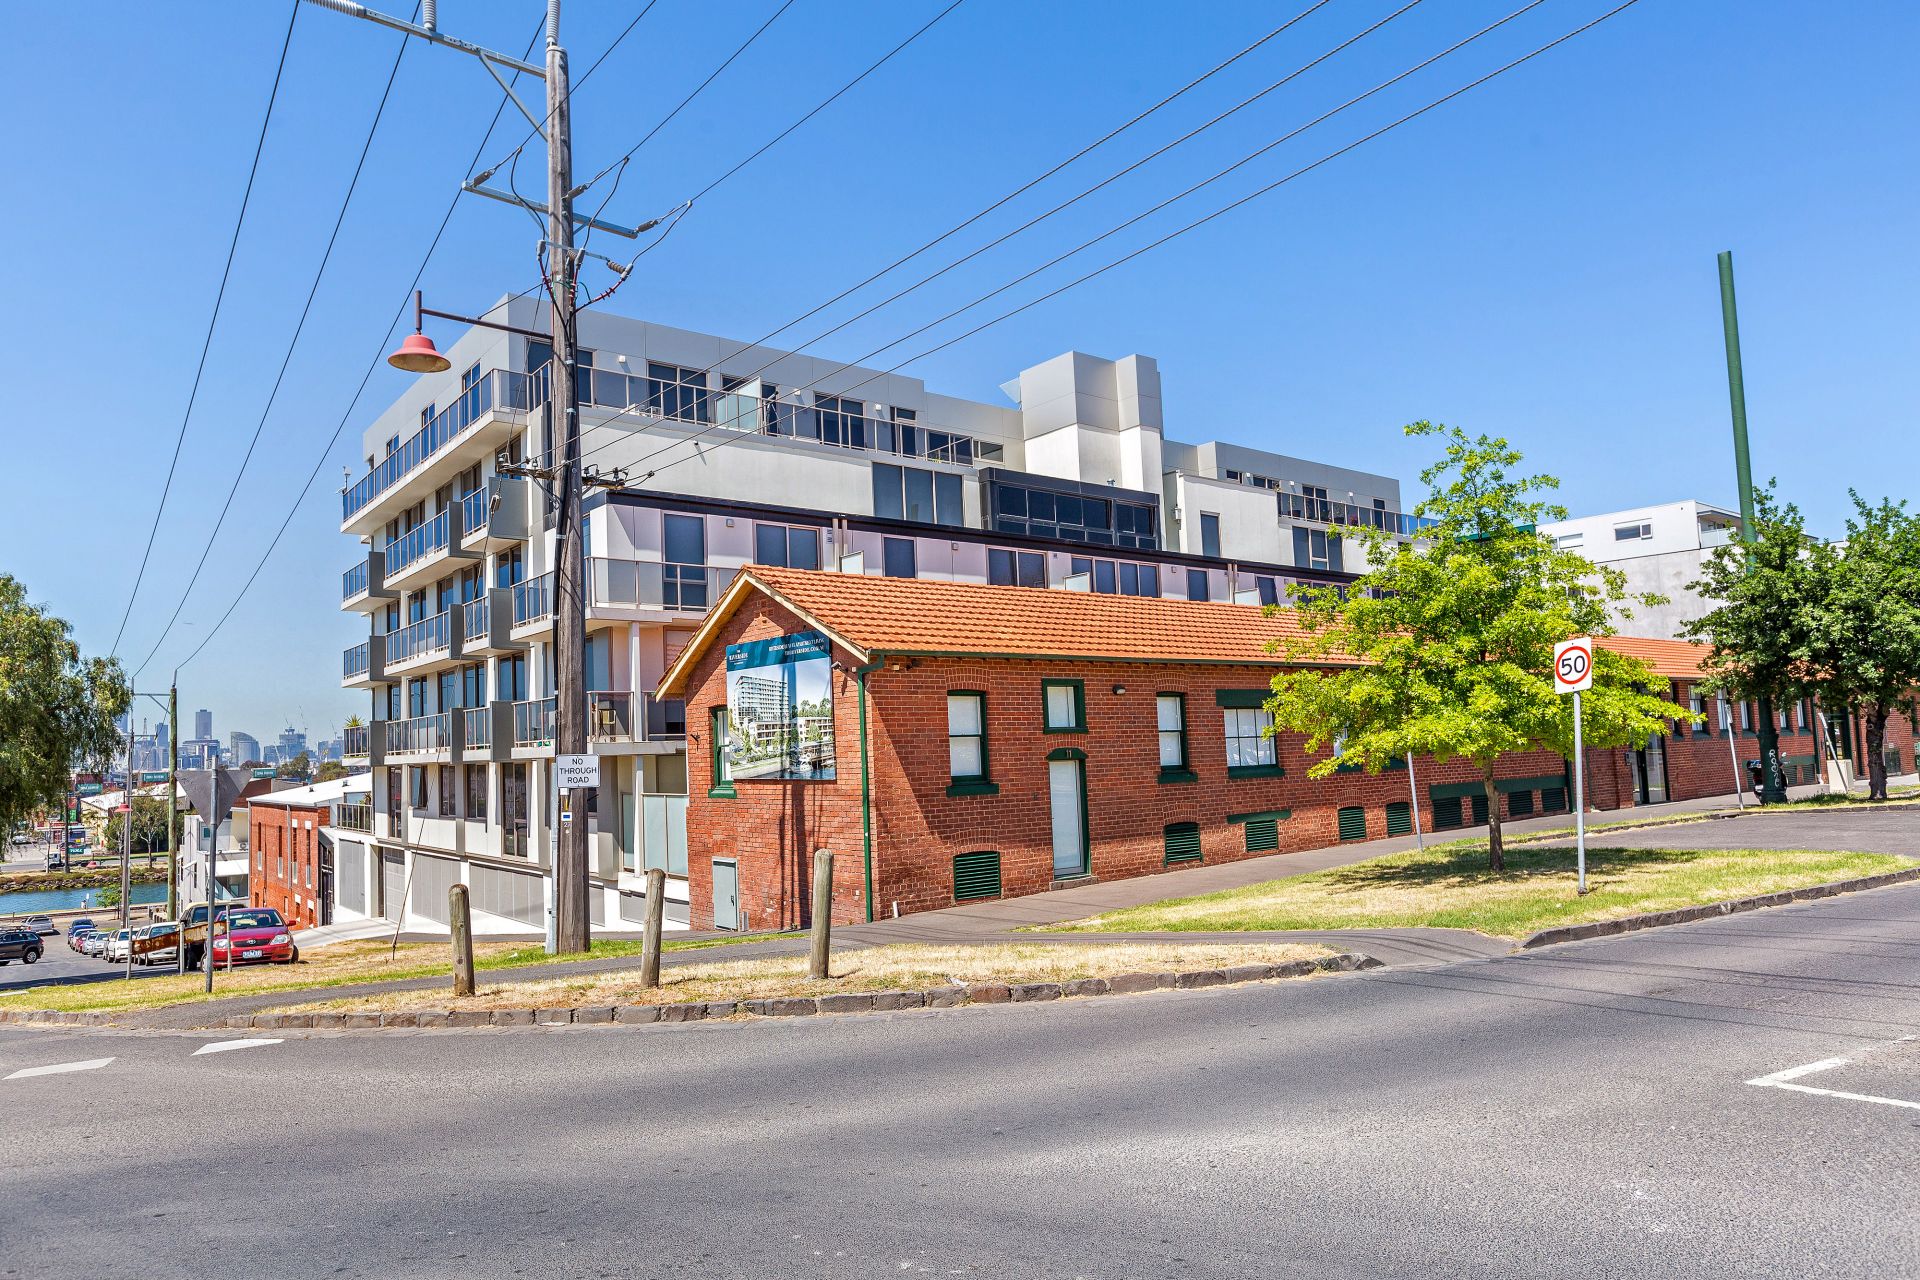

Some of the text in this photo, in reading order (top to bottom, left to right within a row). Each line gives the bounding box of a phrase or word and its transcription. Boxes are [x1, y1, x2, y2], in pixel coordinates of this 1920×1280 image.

[1561, 655, 1586, 677] 50
[571, 758, 584, 766] NO
[559, 766, 597, 776] THROUGH
[567, 776, 590, 784] ROAD
